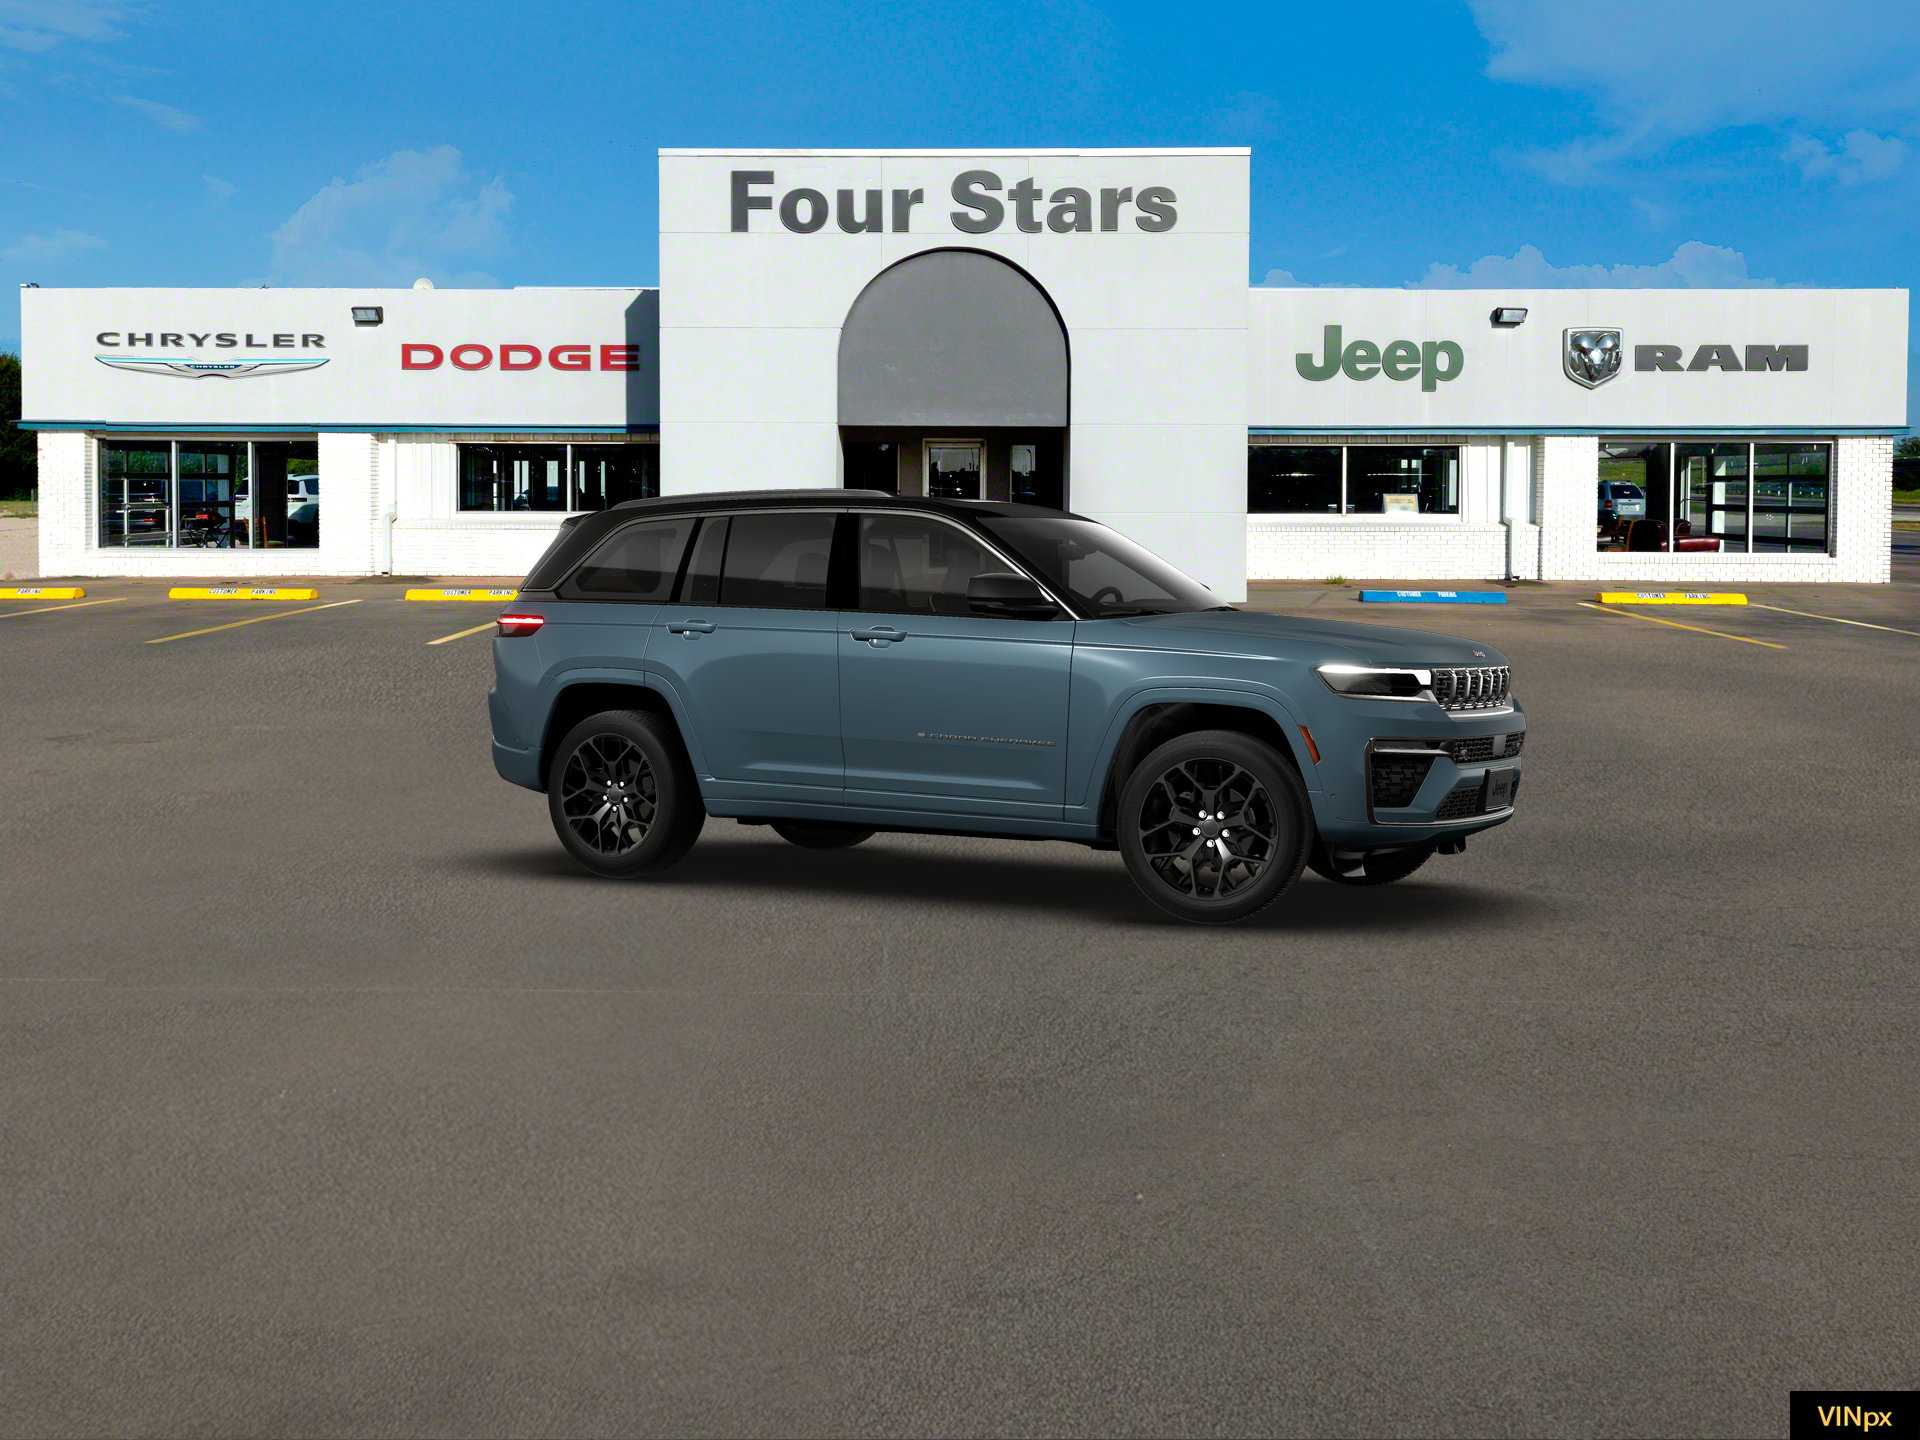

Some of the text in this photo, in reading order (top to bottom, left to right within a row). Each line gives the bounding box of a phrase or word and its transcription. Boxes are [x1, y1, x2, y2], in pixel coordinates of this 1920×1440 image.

[730, 170, 1178, 234] Four Stars
[96, 331, 326, 349] CHRYSLER
[401, 343, 640, 372] DODGE
[1296, 324, 1464, 392] Jeep
[1634, 344, 1809, 372] RAM
[930, 733, 1056, 747] GRAND CHEROKEE
[1491, 778, 1508, 798] Jeep
